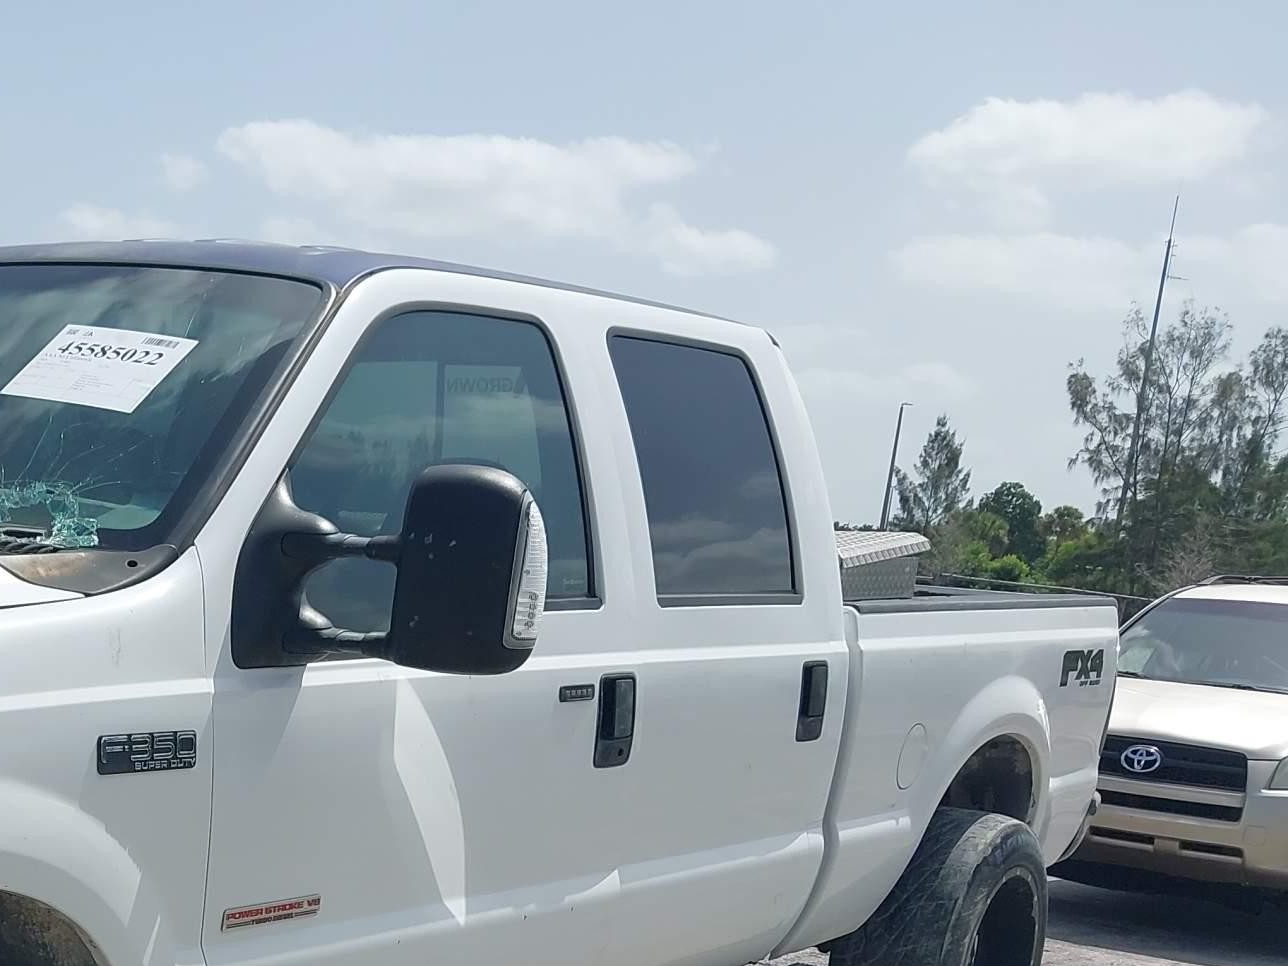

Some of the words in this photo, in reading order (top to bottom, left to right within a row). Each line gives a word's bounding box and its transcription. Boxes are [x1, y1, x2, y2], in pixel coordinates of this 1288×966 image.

[58, 341, 164, 365] 45585022
[1059, 649, 1104, 687] FX4
[134, 761, 169, 770] SUPER
[170, 758, 196, 768] DUTY
[226, 908, 264, 920] POWER
[264, 901, 304, 914] STROKE
